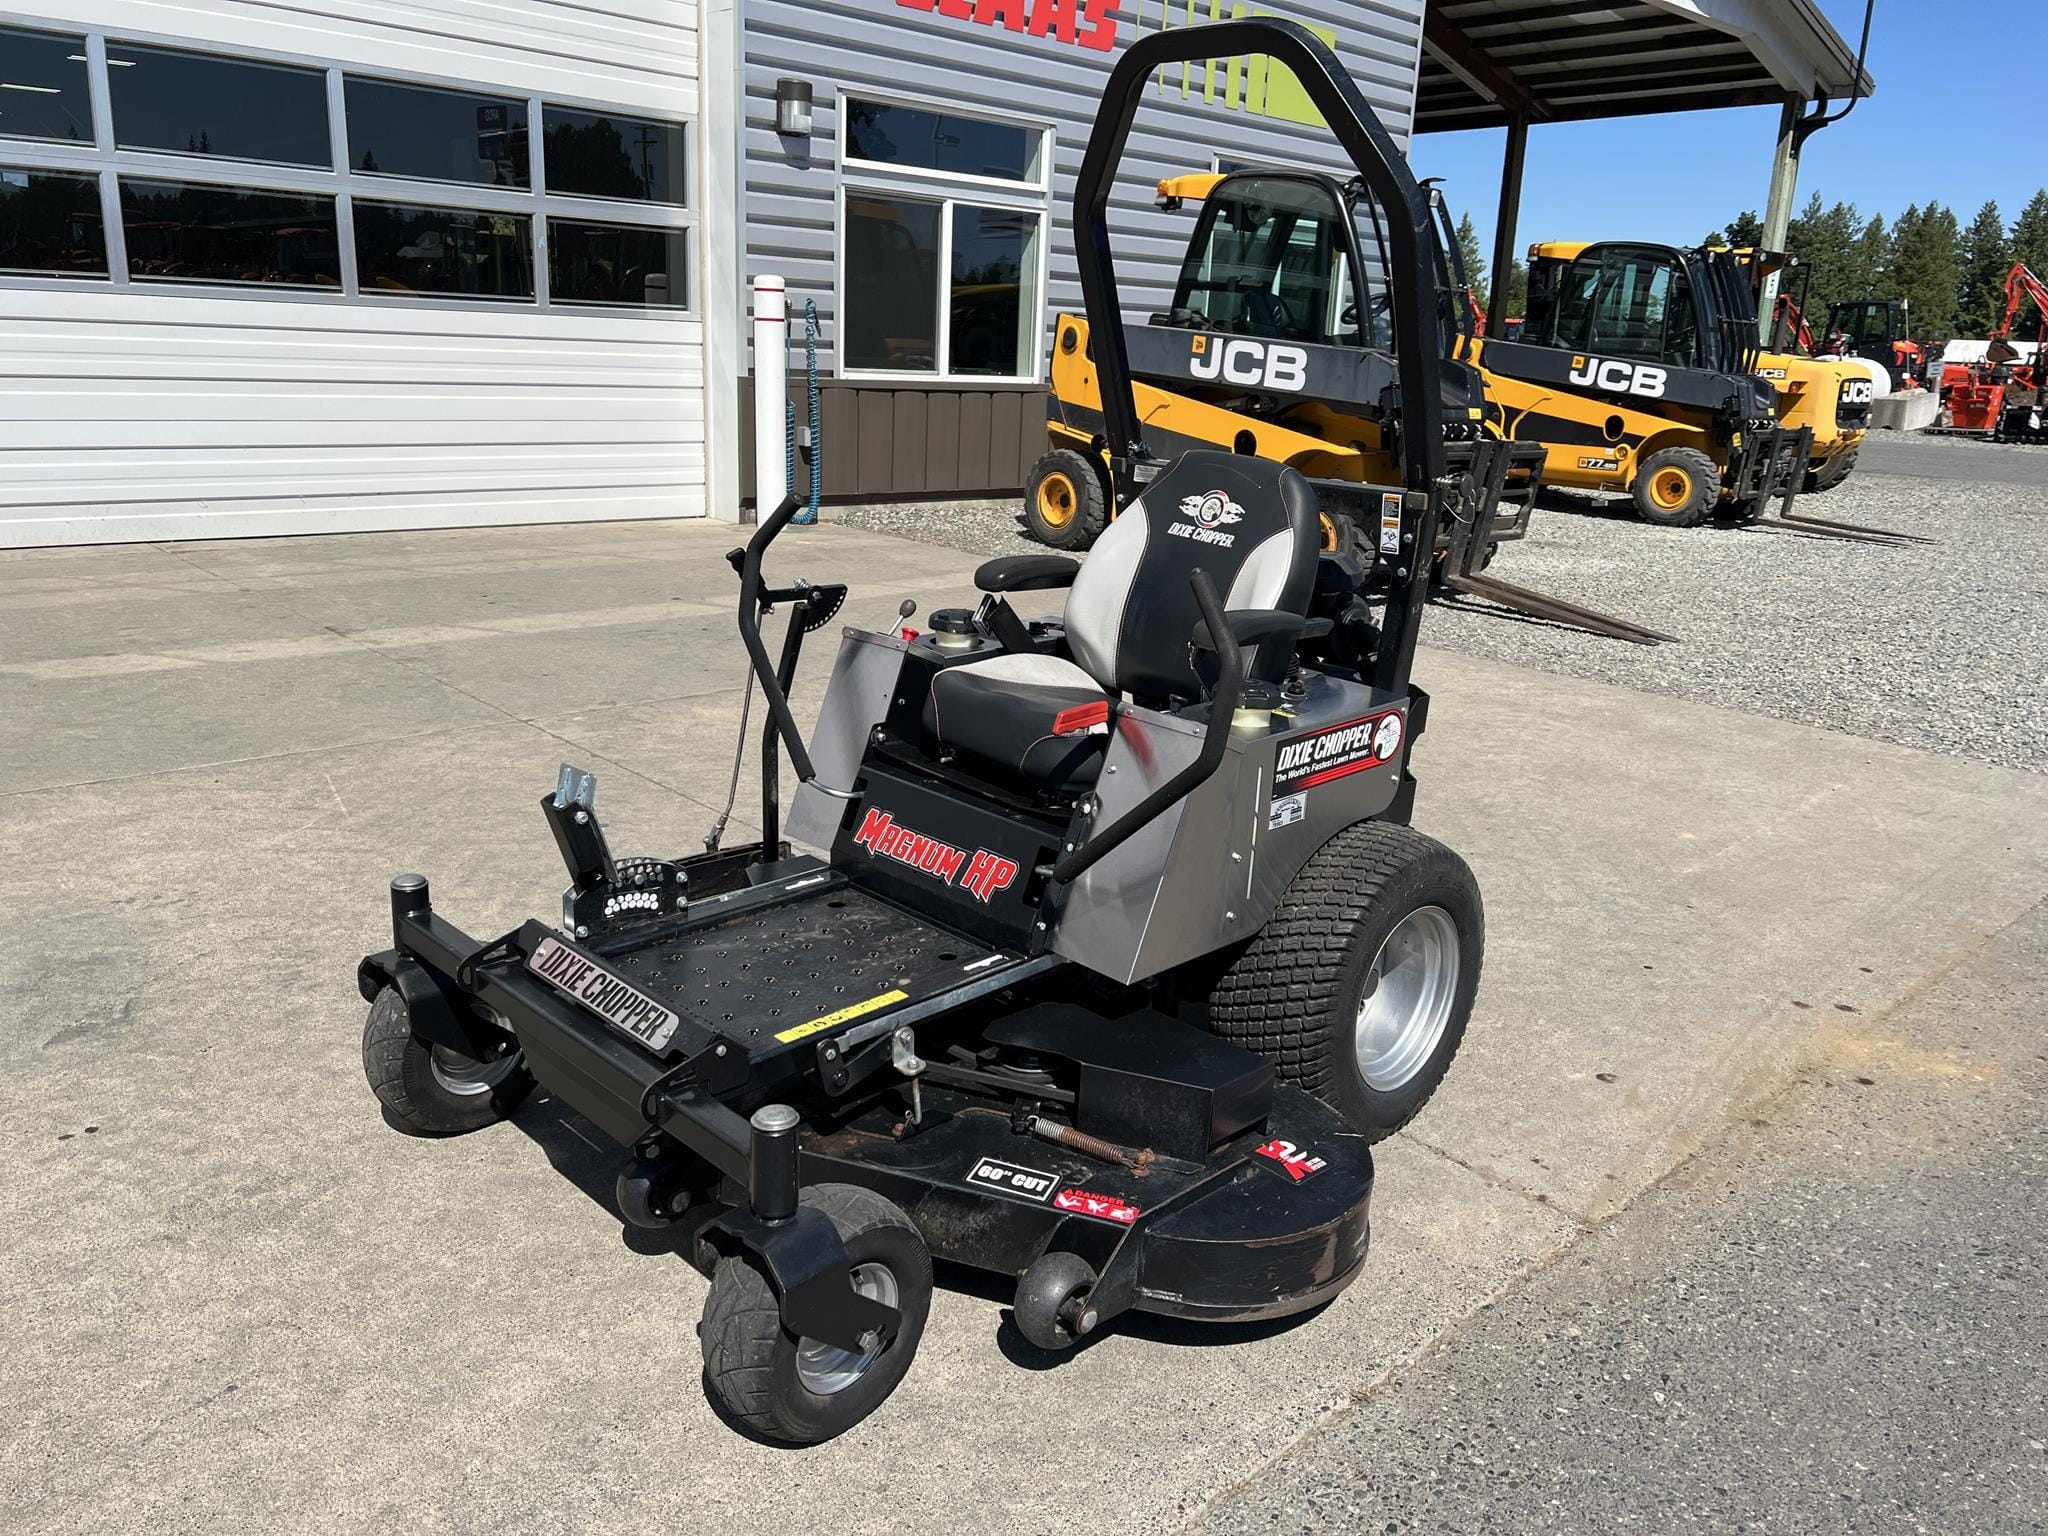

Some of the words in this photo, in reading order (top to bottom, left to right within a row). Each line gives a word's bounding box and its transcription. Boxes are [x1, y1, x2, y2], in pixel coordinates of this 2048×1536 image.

[1190, 337, 1307, 392] JCB
[1569, 358, 1667, 398] JCB
[1755, 368, 1785, 379] JCB
[1841, 381, 1872, 403] JCB
[1167, 522, 1196, 538] DIXIE
[1275, 773, 1287, 783] The
[1288, 765, 1311, 780] World's
[1311, 758, 1334, 772] Fastest
[1334, 754, 1349, 765] Lawn
[1277, 738, 1316, 771] DIXIE
[854, 807, 967, 886] MAGNUM
[960, 849, 1019, 903] HP
[538, 946, 595, 992] DIXIE
[581, 974, 670, 1042] CHOPPER
[977, 1165, 1012, 1181] 60"
[1011, 1174, 1050, 1192] CUT
[1073, 1190, 1125, 1206] DANGER
